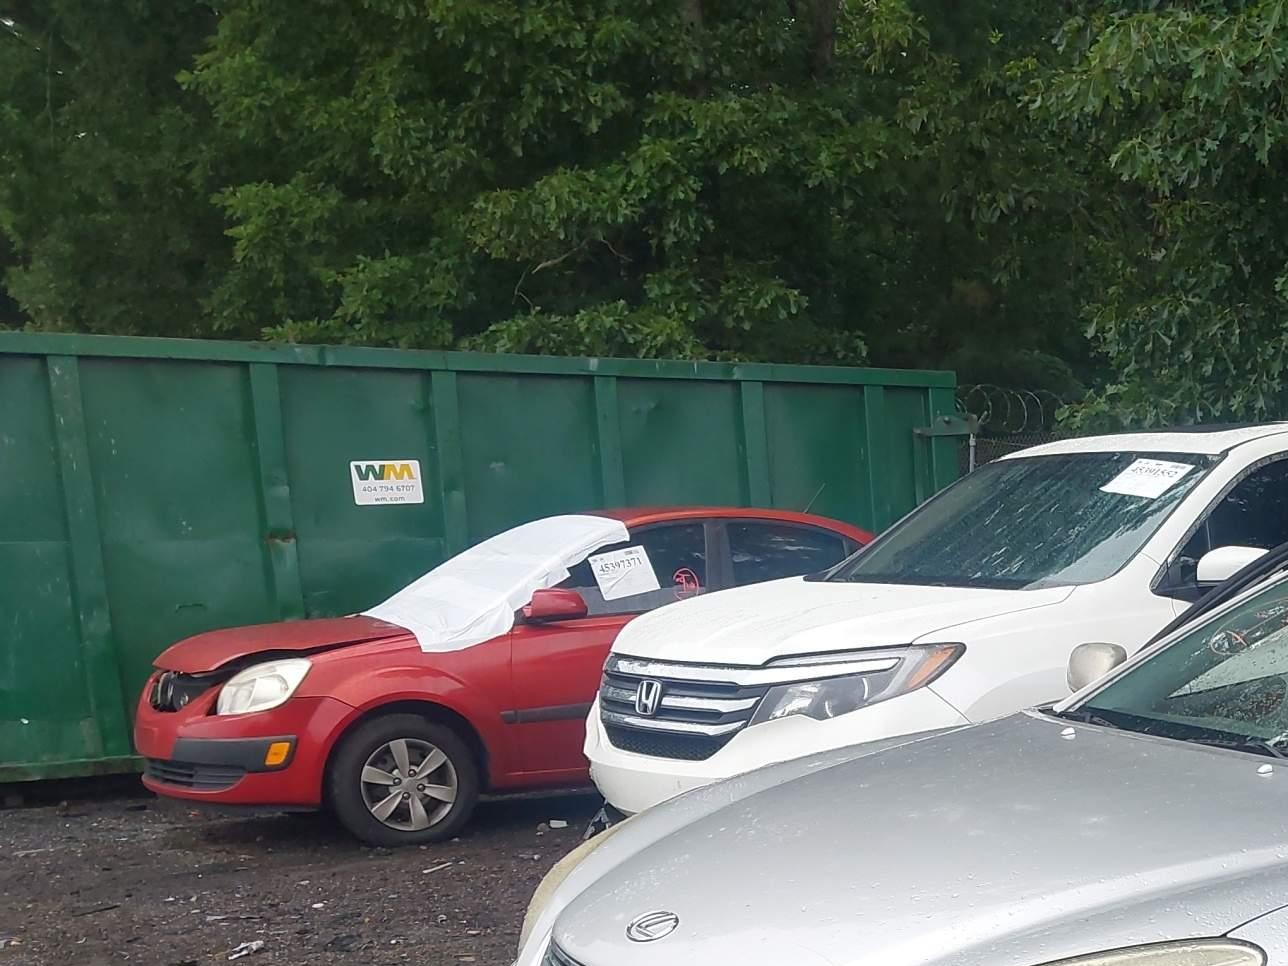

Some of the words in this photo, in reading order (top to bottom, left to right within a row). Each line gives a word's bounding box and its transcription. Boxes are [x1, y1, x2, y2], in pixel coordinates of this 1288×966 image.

[354, 463, 416, 481] WM
[362, 485, 378, 493] 404
[598, 556, 643, 574] 45397371
